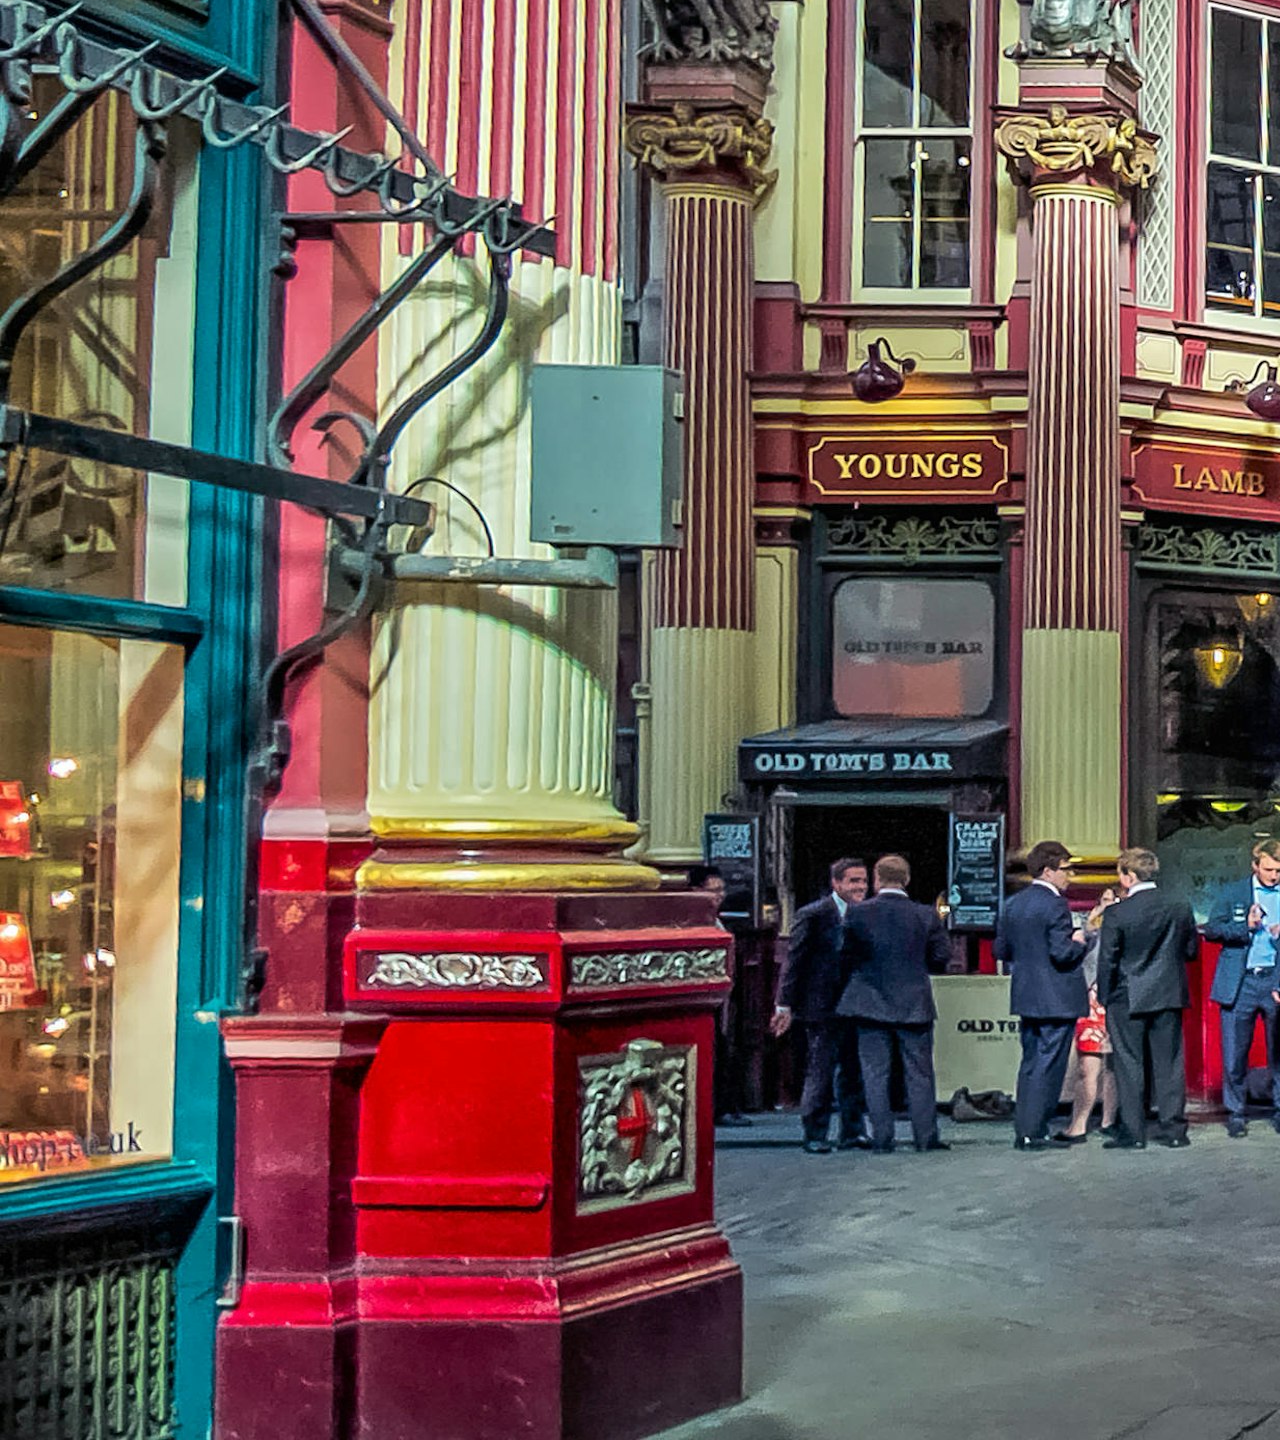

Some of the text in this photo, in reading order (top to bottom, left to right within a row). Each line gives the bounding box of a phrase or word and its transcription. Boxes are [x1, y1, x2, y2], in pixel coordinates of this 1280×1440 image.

[832, 452, 983, 479] YOUNGS
[1172, 463, 1265, 496] LAMB
[942, 640, 984, 654] BAR
[755, 752, 953, 772] OLD TOM'S BAR
[957, 1019, 1021, 1033] OLD TO
